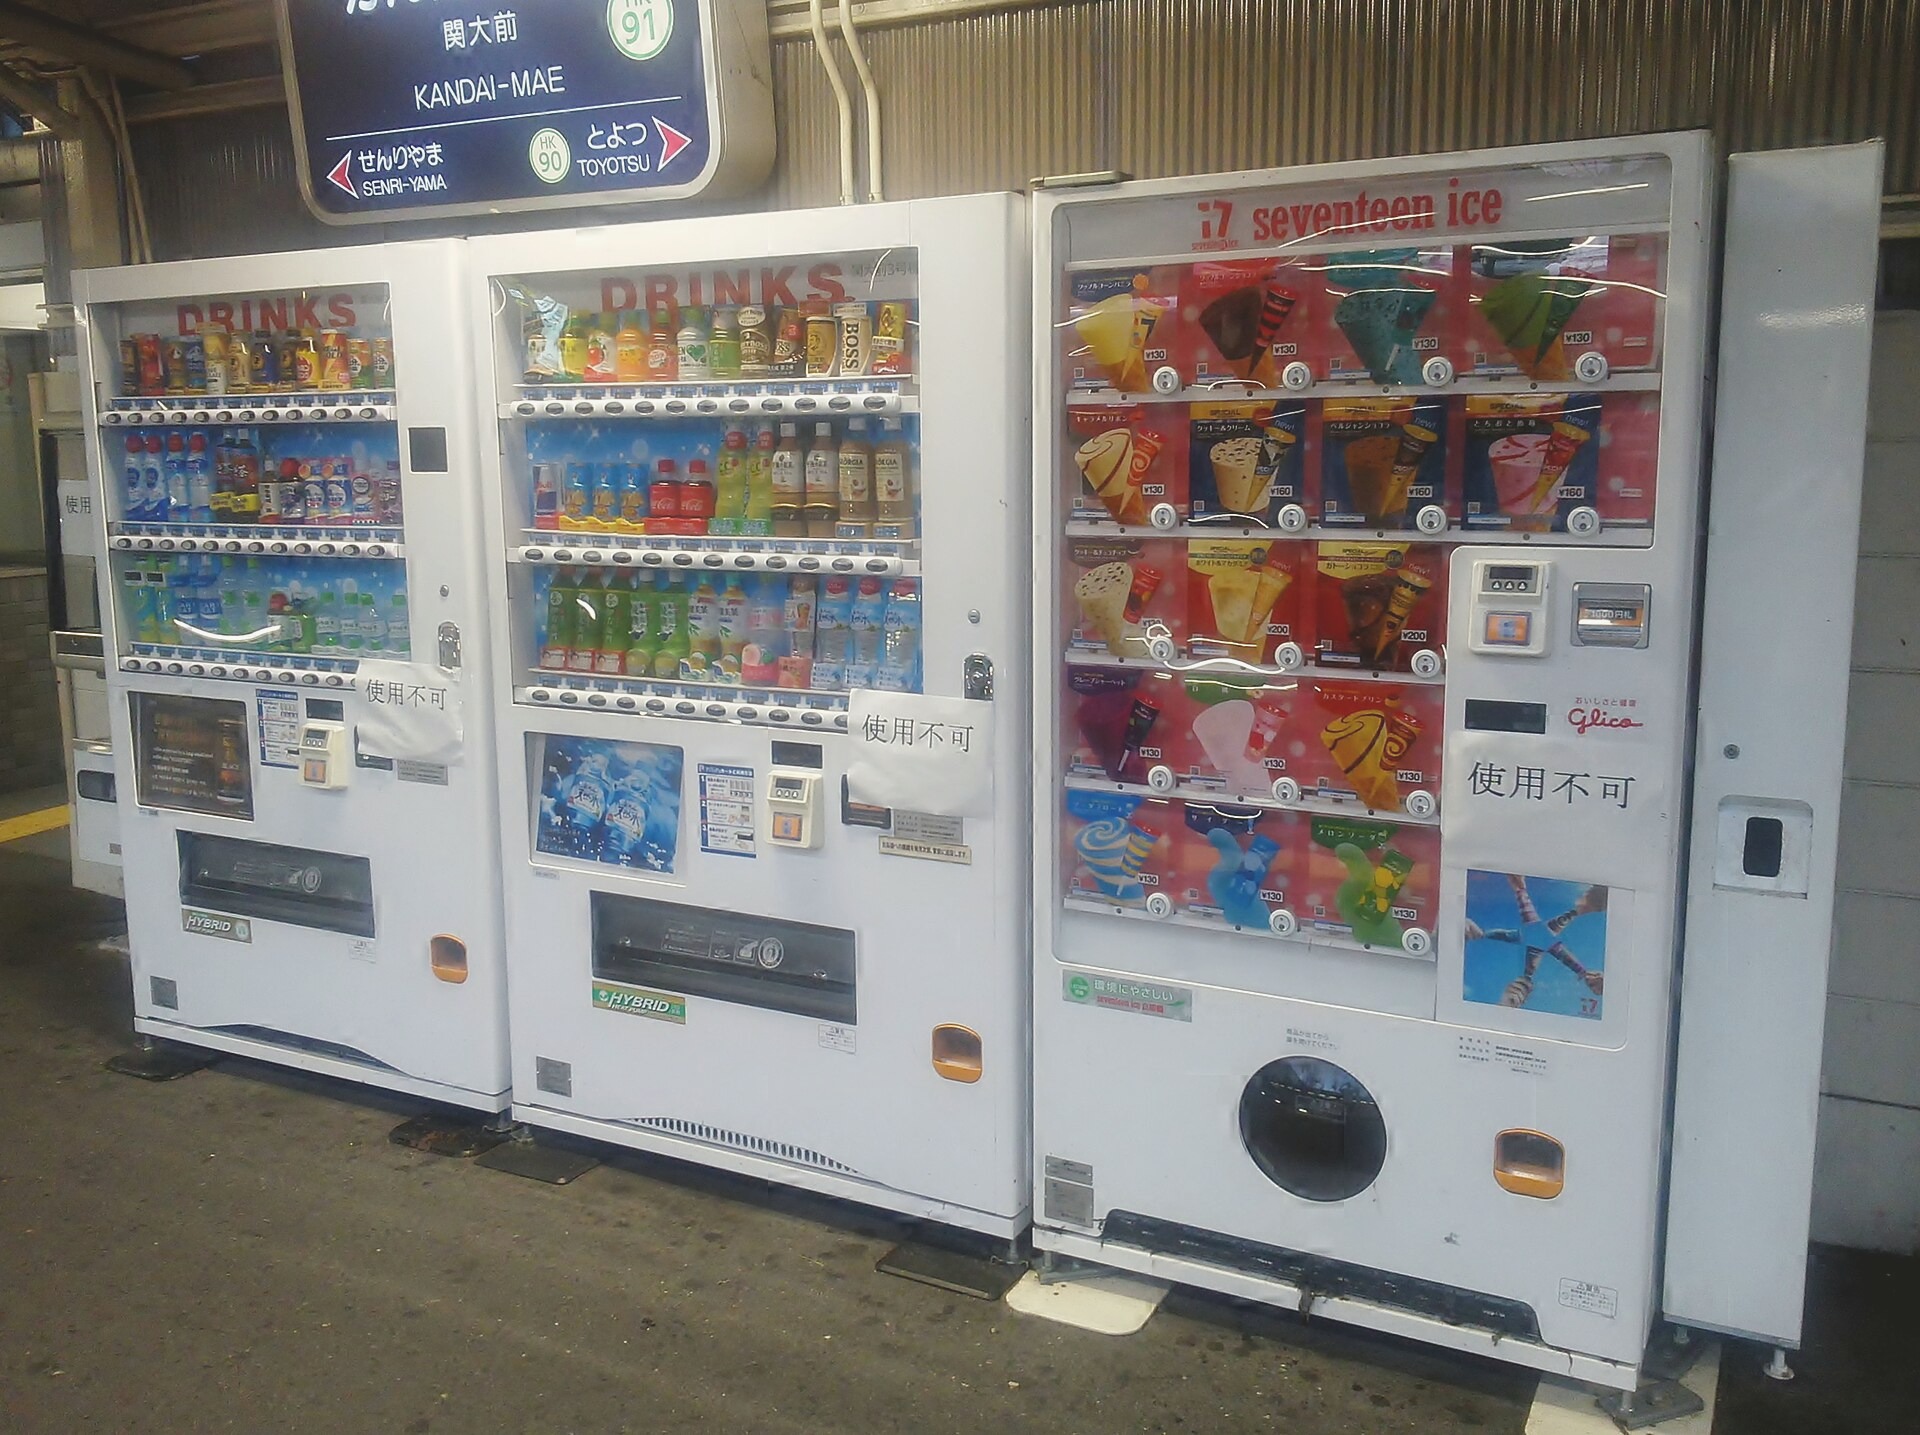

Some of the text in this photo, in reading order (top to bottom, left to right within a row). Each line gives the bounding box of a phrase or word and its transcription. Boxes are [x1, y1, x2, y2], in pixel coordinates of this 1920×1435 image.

[442, 10, 518, 51] 関大前
[621, 8, 656, 45] 91
[414, 65, 566, 110] KANDAI-MAE
[539, 135, 557, 150] HK
[587, 121, 648, 150] とよつ
[358, 142, 444, 173] せんりやま
[538, 150, 562, 172] 90
[576, 153, 650, 177] TOYOTSU
[362, 173, 447, 197] SENRI-YAMA
[1252, 177, 1504, 241] seventeen ice
[602, 262, 854, 313] DRINKS
[176, 293, 357, 337] DRINKS
[844, 322, 860, 370] BOSS
[1414, 339, 1437, 348] ¥130
[1565, 332, 1590, 342] ¥130
[1145, 350, 1165, 359] ¥130
[1274, 344, 1295, 354] ¥130
[1144, 485, 1163, 494] ¥130
[1270, 486, 1291, 496] ¥160
[1408, 487, 1431, 497] ¥160
[1558, 487, 1583, 497] ¥160
[65, 495, 91, 514] 使用
[1267, 625, 1288, 634] ¥200
[1403, 631, 1426, 641] ¥200
[366, 678, 448, 712] 使用不可
[1567, 707, 1644, 735] Glico
[861, 713, 975, 753] 使用不可
[1141, 748, 1160, 757] ¥130
[1264, 759, 1284, 768] ¥130
[1398, 771, 1420, 781] ¥130
[1466, 761, 1637, 810] 使用不可
[1139, 875, 1158, 884] ¥130
[1261, 891, 1282, 901] ¥130
[186, 914, 232, 932] HYBRID
[1394, 909, 1415, 919] ¥130
[1093, 978, 1174, 1001] 環境にやさしい
[607, 991, 670, 1013] HYBRID
